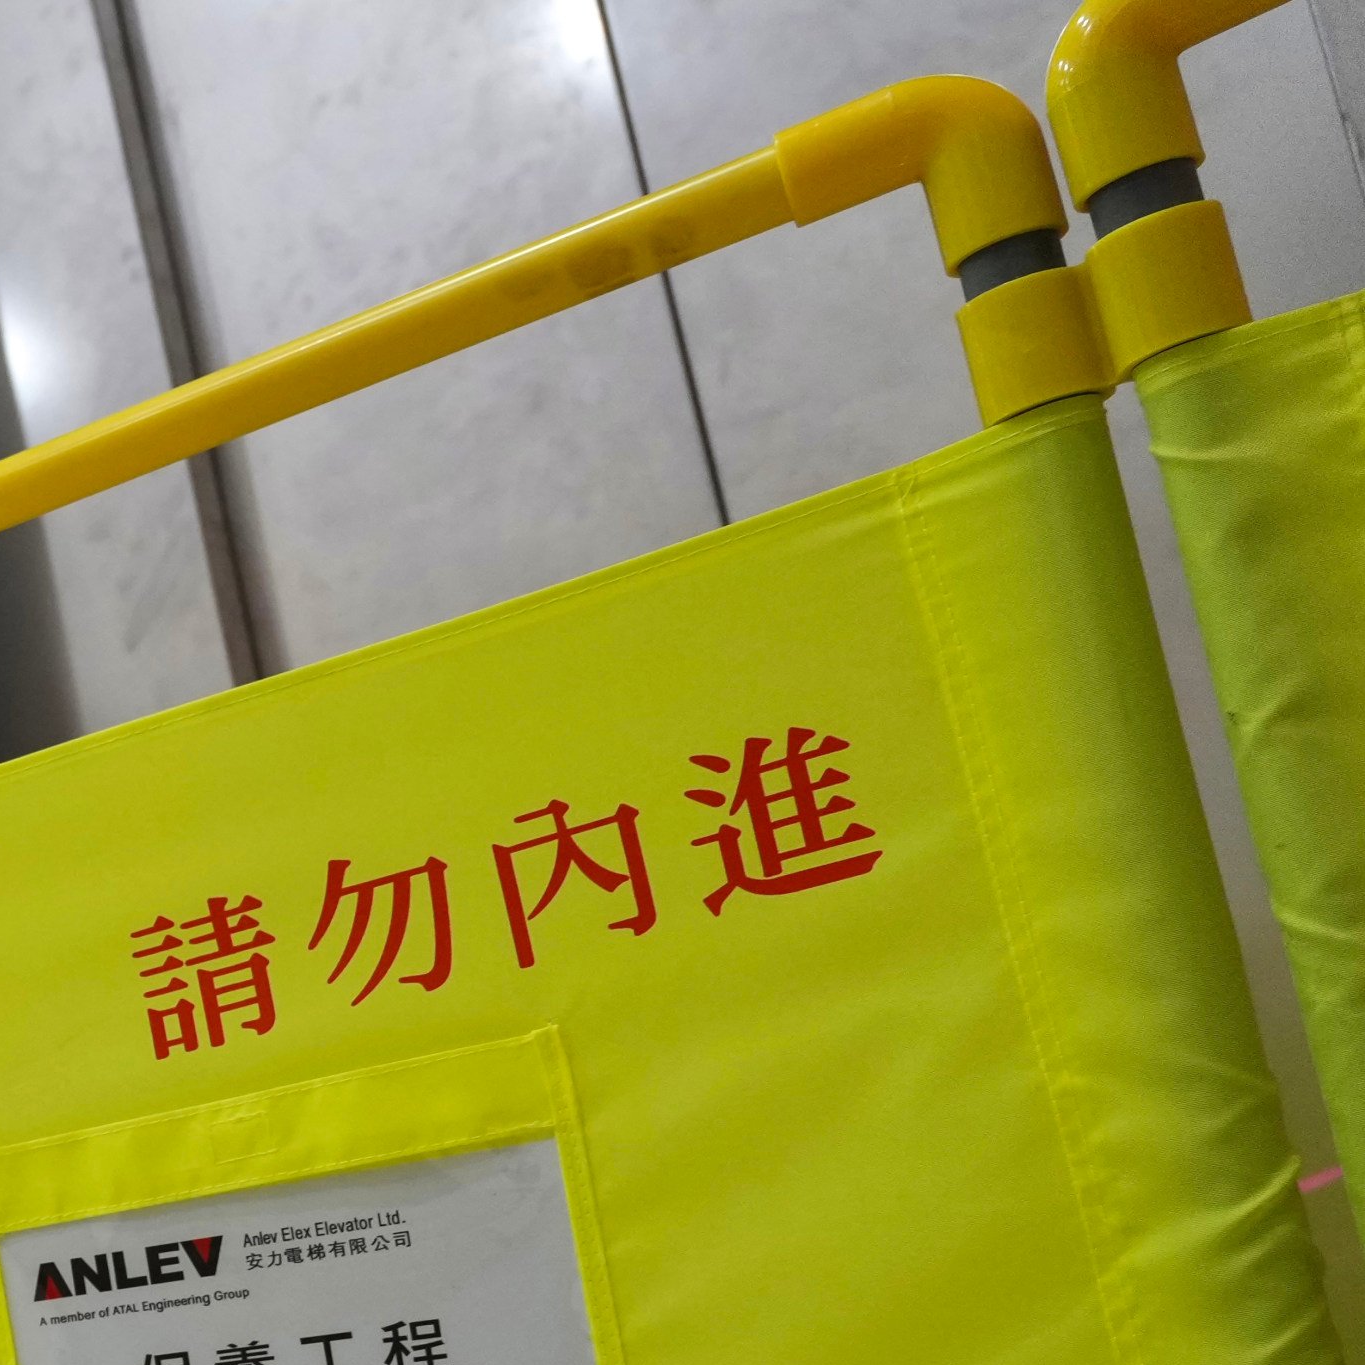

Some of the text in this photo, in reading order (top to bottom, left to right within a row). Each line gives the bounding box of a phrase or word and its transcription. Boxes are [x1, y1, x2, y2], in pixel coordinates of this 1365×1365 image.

[130, 726, 884, 1061] 請勿內進
[243, 1210, 407, 1248] Anlev Elex Elevator Ltd.
[34, 1235, 223, 1302] ANLEV
[245, 1230, 412, 1271] 安力電梯有限公司
[39, 1287, 250, 1326] A member of ATAL Engineering Group
